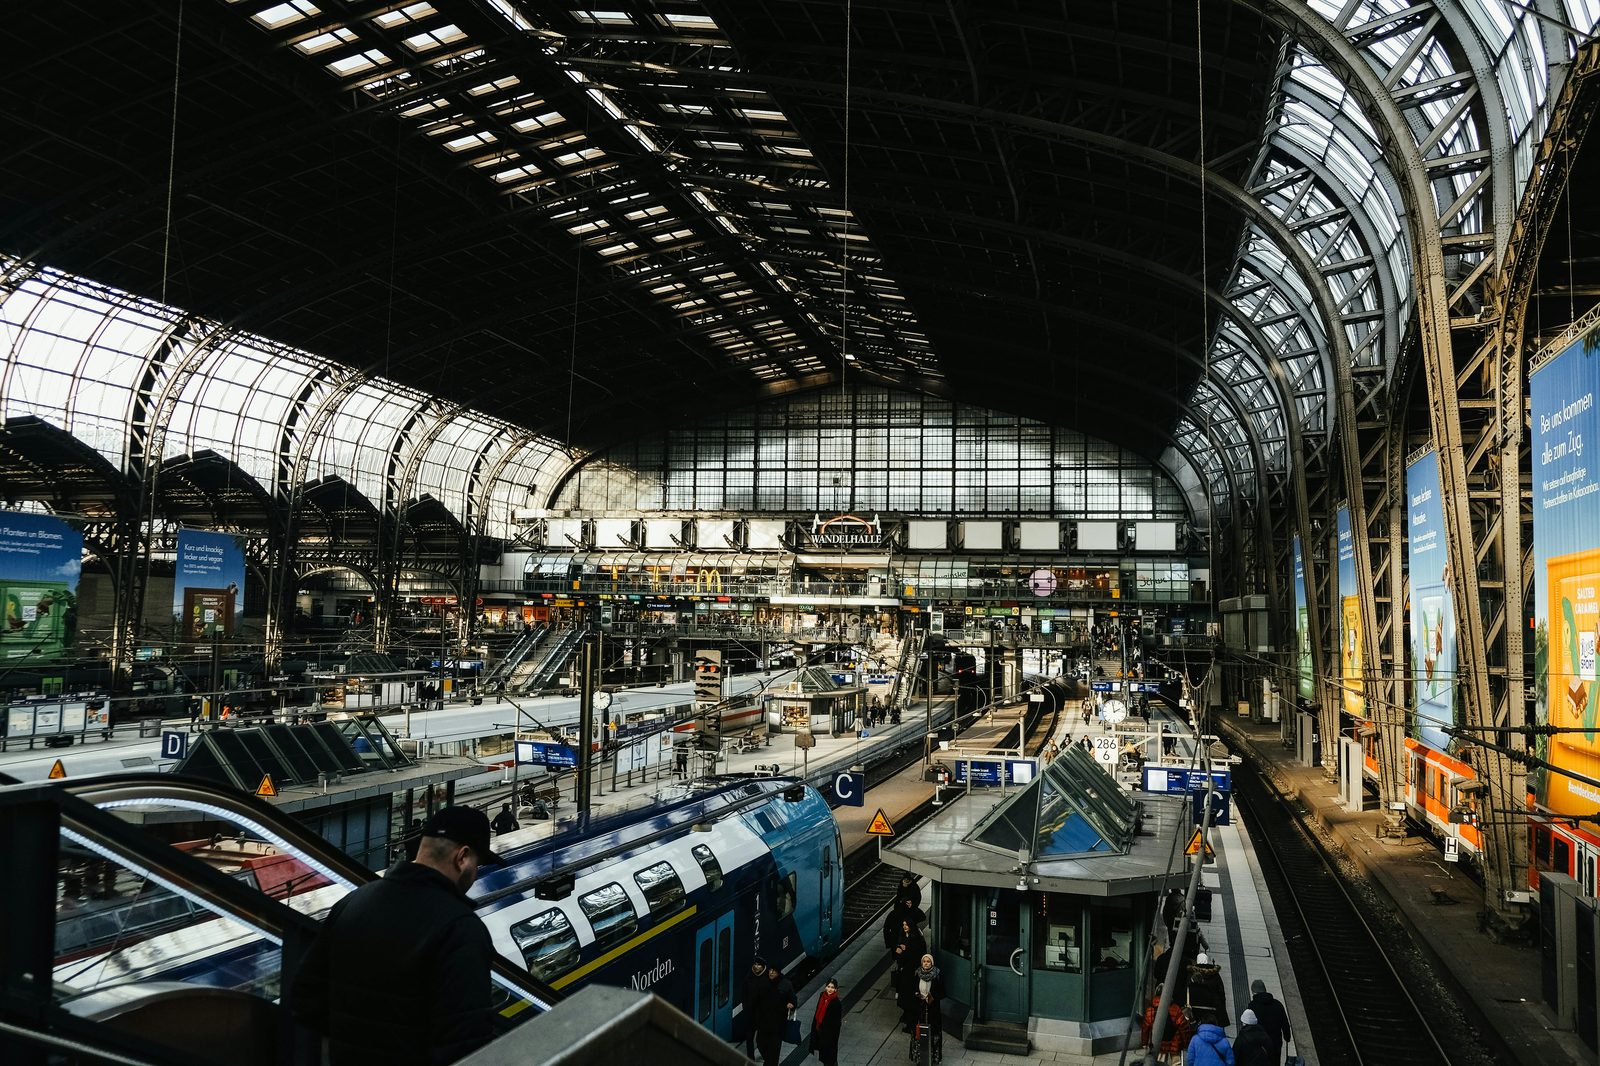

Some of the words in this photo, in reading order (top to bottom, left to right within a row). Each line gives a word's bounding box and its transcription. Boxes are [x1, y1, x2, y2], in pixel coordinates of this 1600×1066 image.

[1540, 412, 1551, 435] Bei
[1551, 410, 1562, 429] uns
[1562, 392, 1593, 422] kommen
[1541, 442, 1553, 466] alle
[1553, 441, 1567, 461] zum
[1568, 430, 1584, 457] Zug.
[811, 534, 882, 544] WANDELHALLE
[184, 543, 195, 551] Kurz
[195, 544, 205, 552] und
[1576, 586, 1596, 600] SALTED
[1575, 601, 1599, 615] CARAMEL
[1580, 659, 1595, 670] SPORT
[167, 734, 181, 755] D
[1096, 738, 1117, 749] 286
[1102, 750, 1110, 761] 6
[835, 773, 853, 799] C
[1446, 838, 1457, 853] H
[631, 957, 675, 991] Norden.
